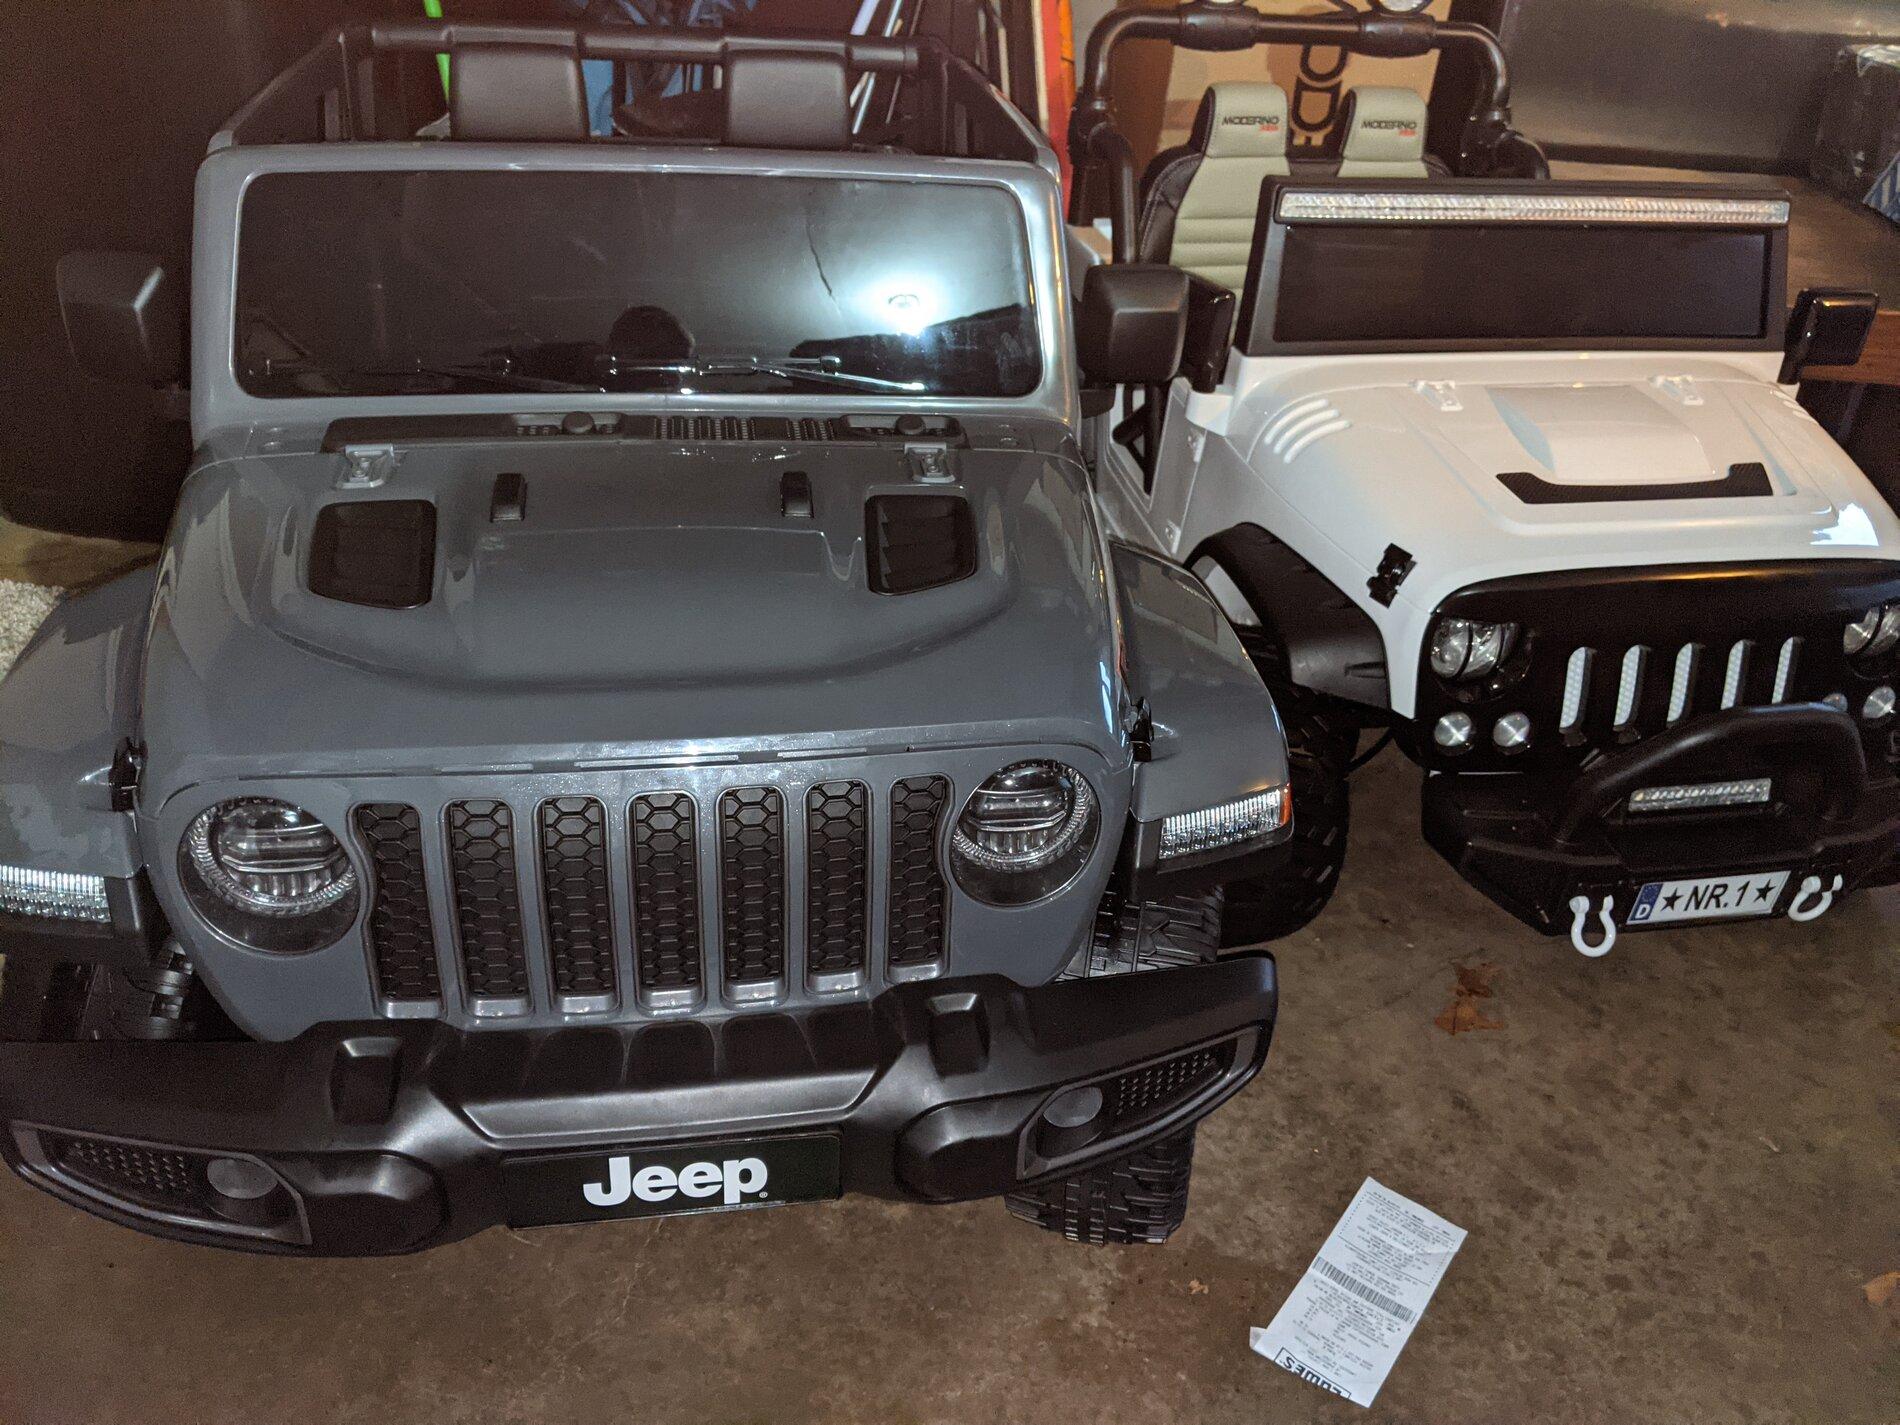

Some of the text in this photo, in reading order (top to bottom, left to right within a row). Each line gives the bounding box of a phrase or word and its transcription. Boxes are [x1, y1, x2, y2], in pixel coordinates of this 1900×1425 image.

[1221, 115, 1280, 126] MODERNO
[1360, 119, 1418, 130] MODERNO
[1684, 881, 1751, 911] NR.1
[1636, 905, 1650, 918] D
[582, 1156, 768, 1206] Jeep
